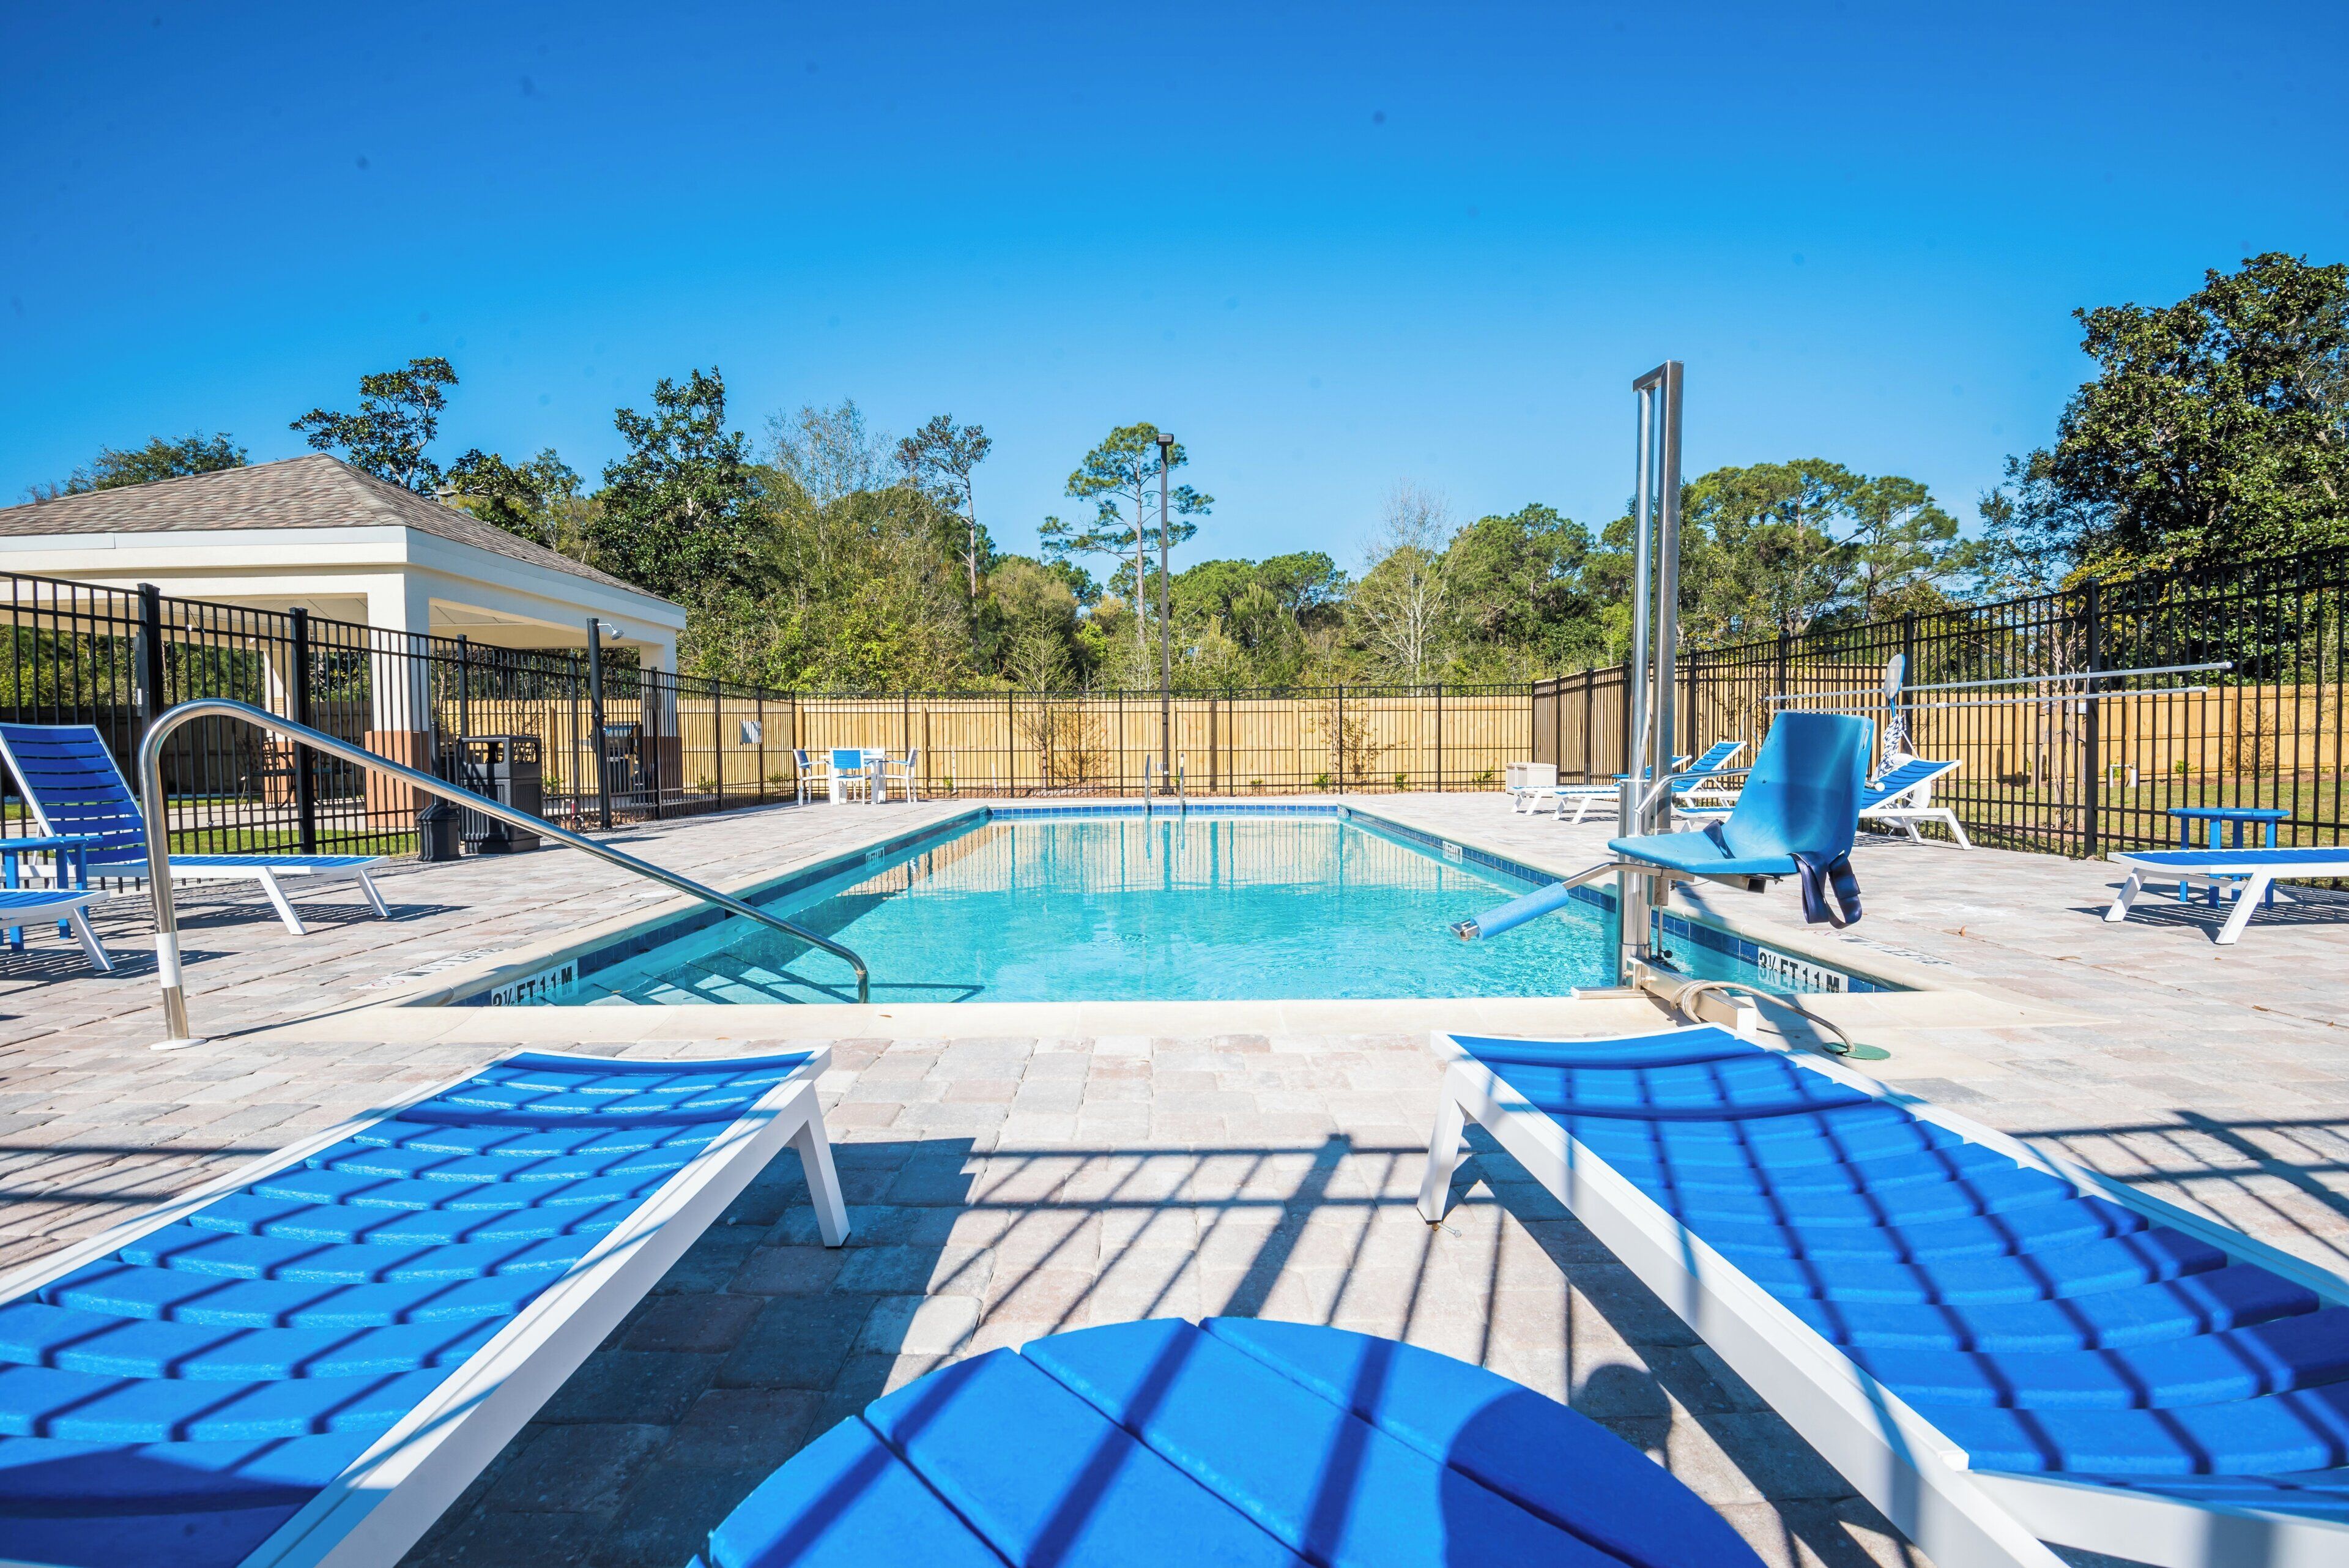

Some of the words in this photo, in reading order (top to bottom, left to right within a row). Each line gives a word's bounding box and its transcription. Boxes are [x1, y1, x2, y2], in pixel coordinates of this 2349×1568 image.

[517, 979, 536, 1003] FT
[561, 966, 573, 985] M
[1781, 959, 1798, 979] FT
[1827, 974, 1839, 993] M
